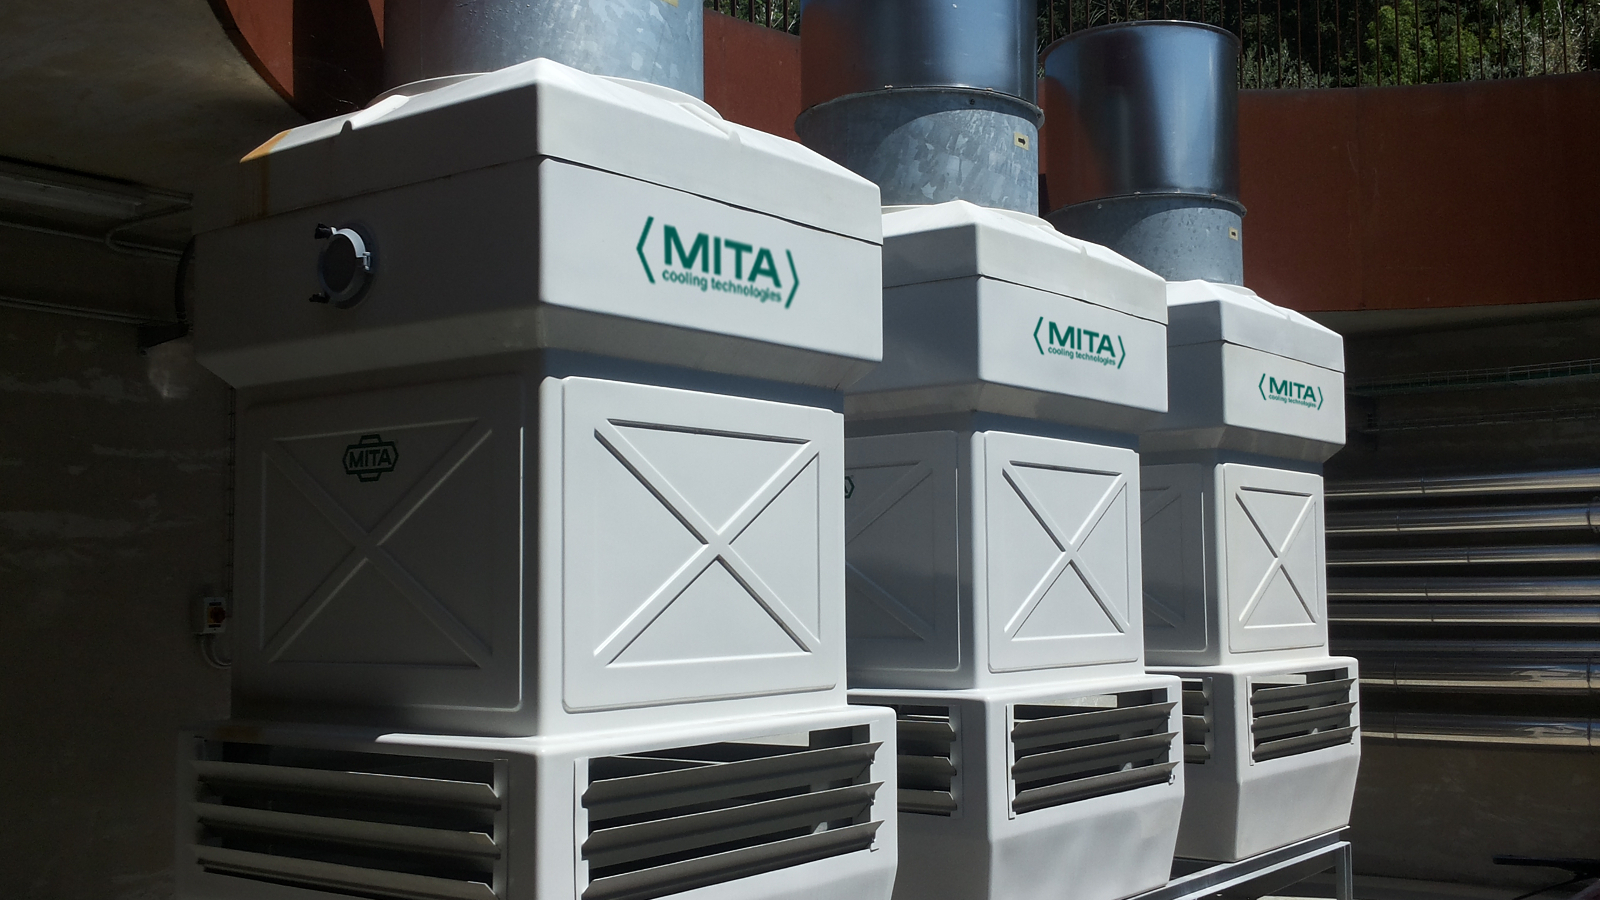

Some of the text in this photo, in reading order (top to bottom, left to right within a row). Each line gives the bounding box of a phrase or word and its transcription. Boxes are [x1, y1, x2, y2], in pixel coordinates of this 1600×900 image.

[664, 224, 782, 289] MITA
[662, 269, 782, 304] cooling technologies
[1049, 321, 1116, 358] MITA
[1048, 346, 1116, 366] cooling technologies
[1269, 376, 1317, 403] MITA
[349, 448, 392, 468] MITA
